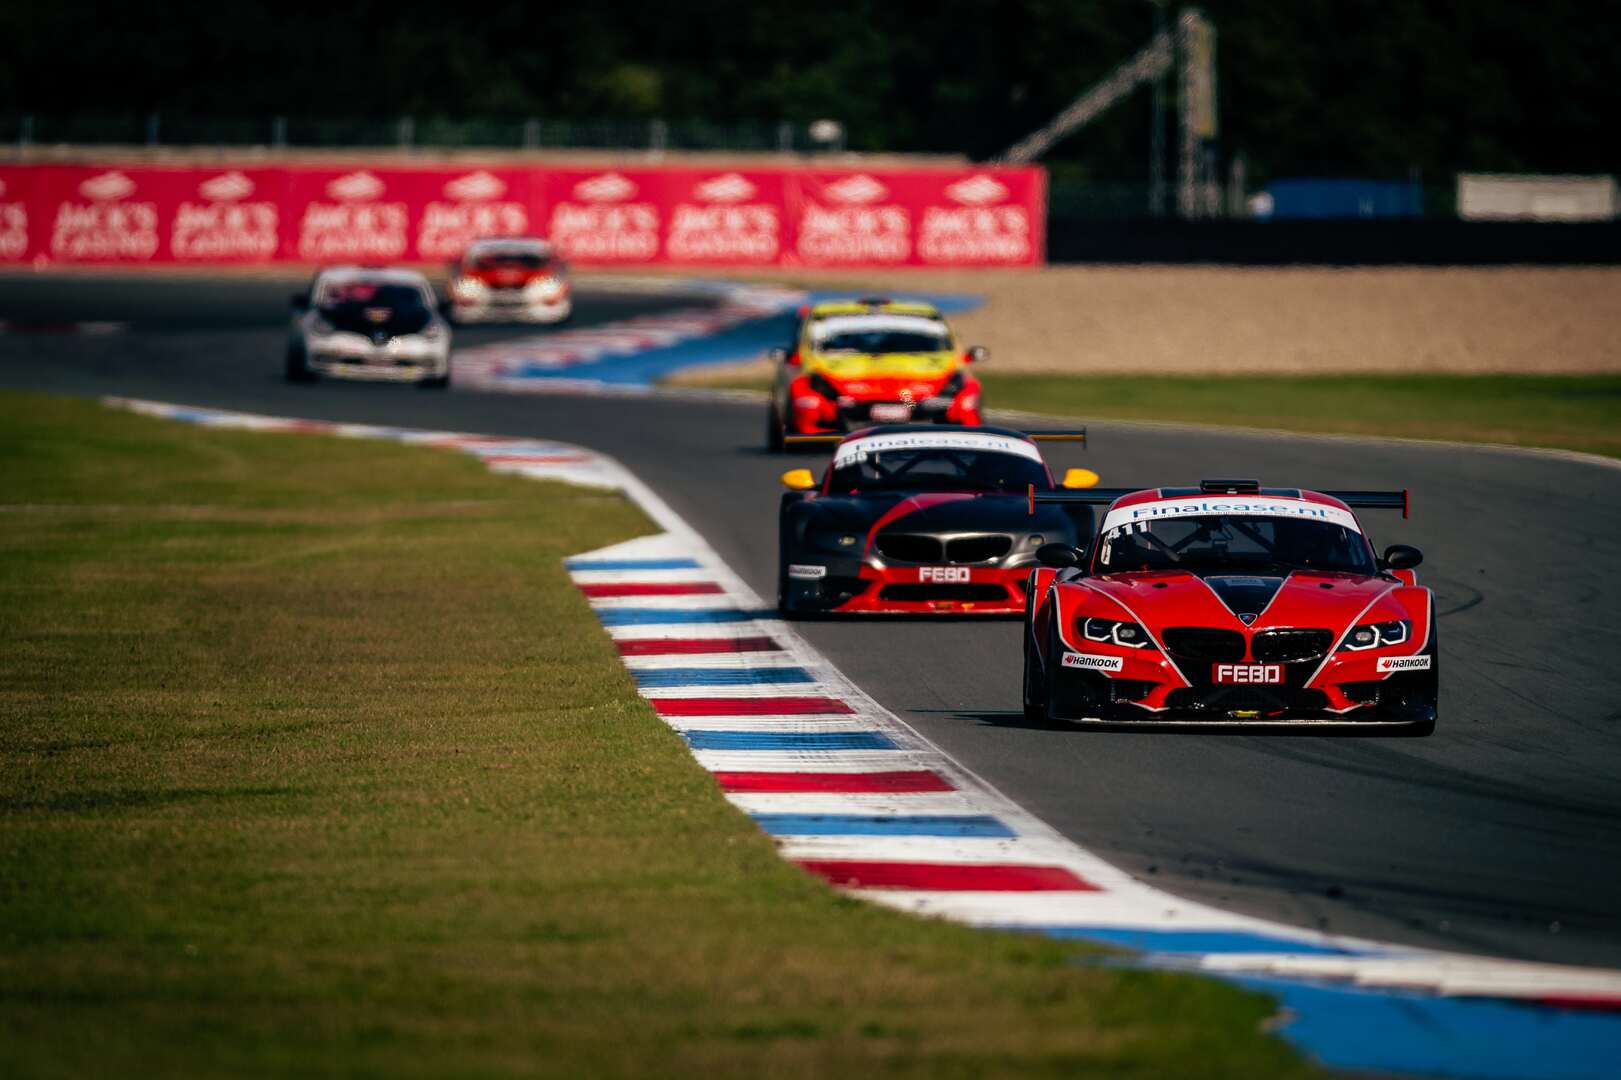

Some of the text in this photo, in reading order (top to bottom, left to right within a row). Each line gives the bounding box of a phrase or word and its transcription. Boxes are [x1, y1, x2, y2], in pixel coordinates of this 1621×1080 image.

[1133, 503, 1326, 518] Finalease.nl
[1108, 520, 1148, 539] 411
[919, 567, 970, 582] FEBO
[1217, 665, 1280, 683] FEBO
